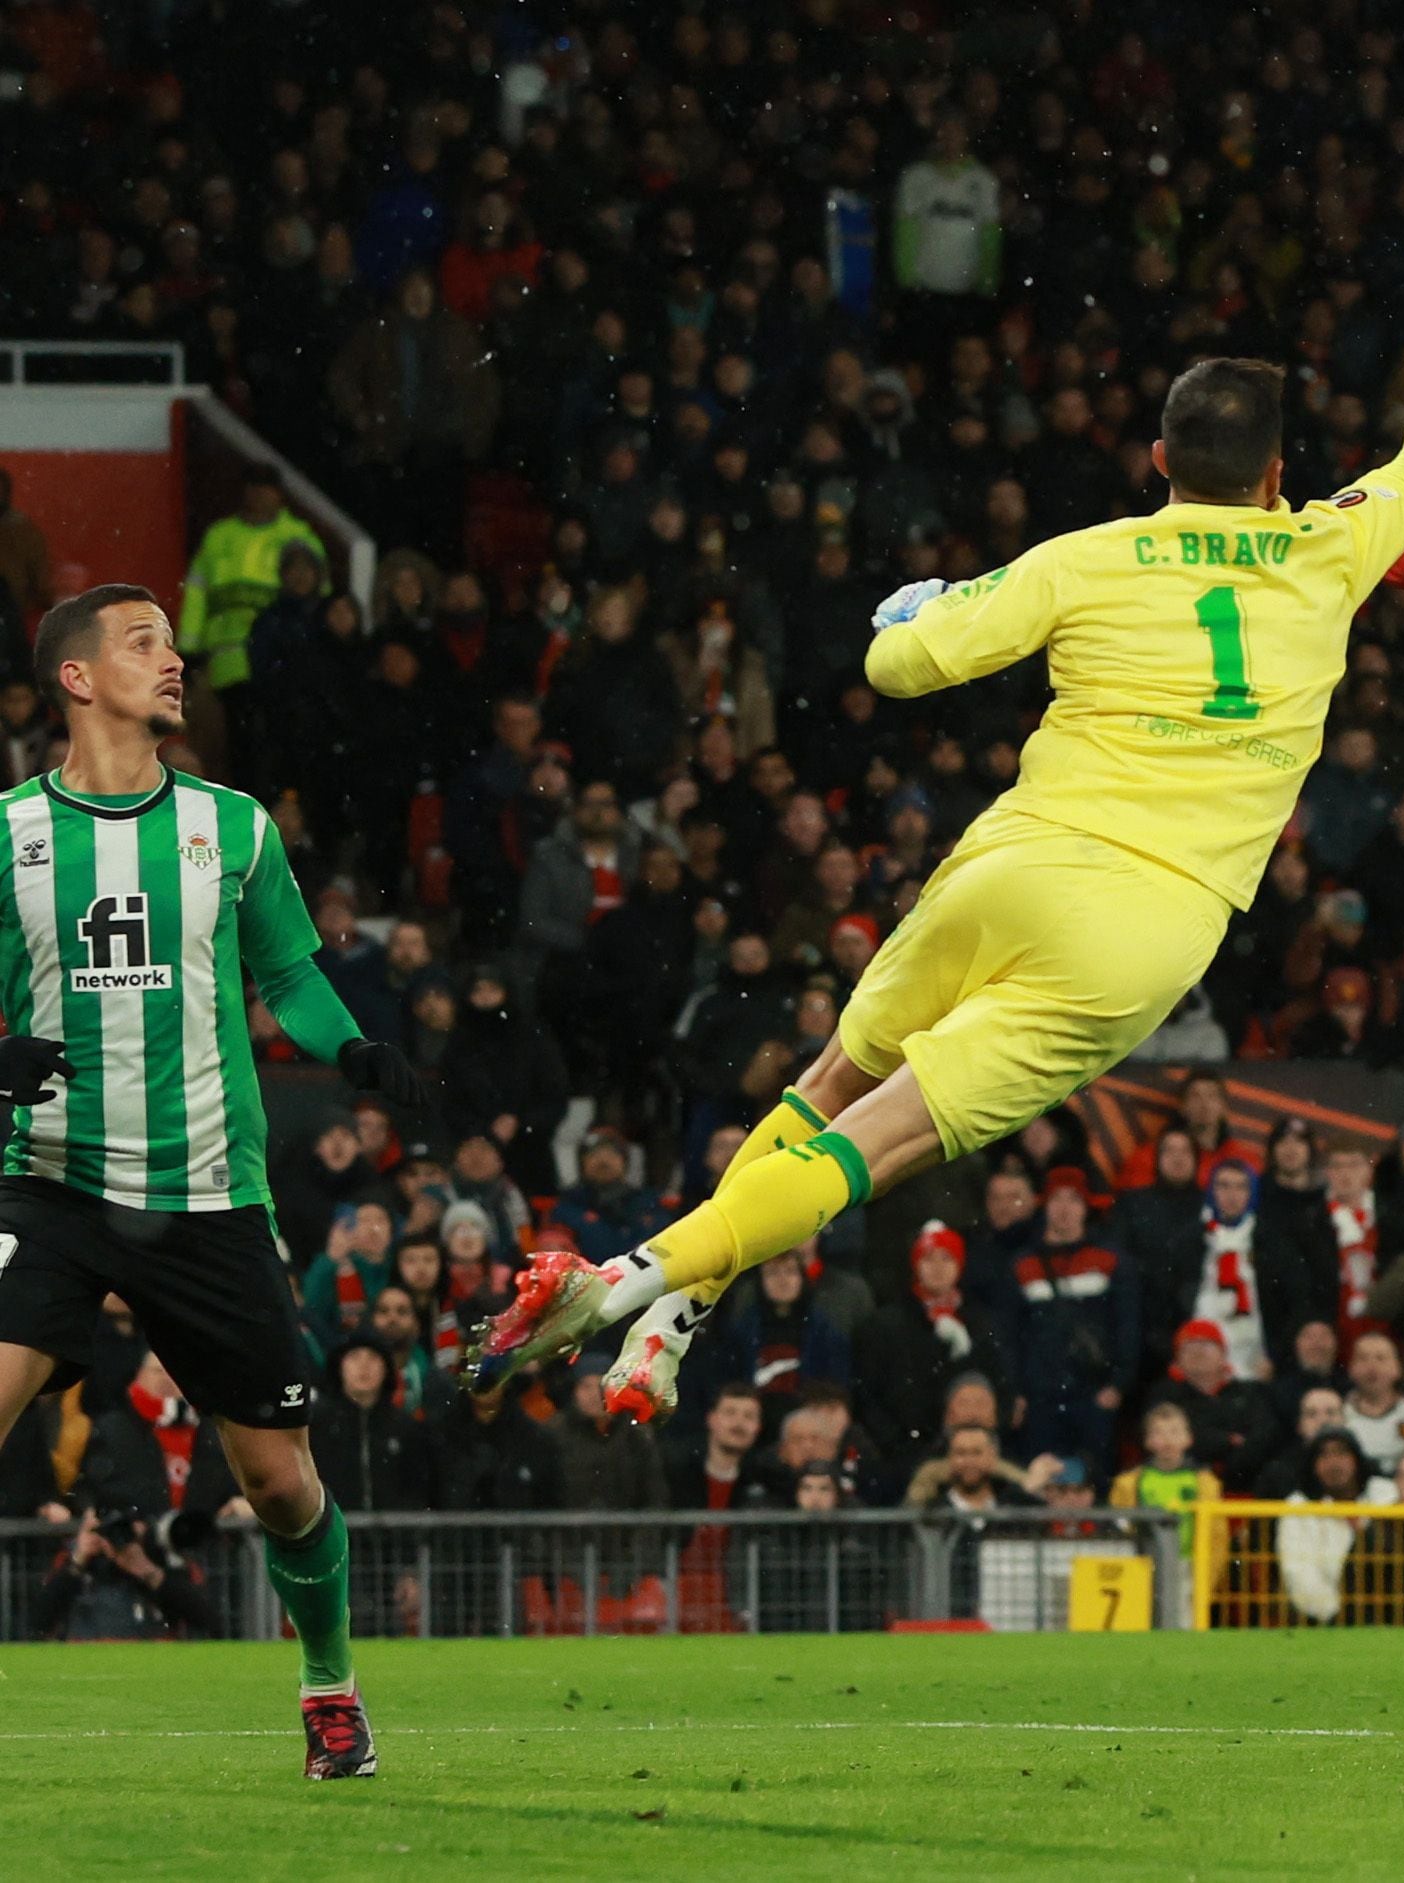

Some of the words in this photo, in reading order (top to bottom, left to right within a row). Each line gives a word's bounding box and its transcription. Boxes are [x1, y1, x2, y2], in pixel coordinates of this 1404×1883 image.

[1135, 536, 1170, 565] C.
[1177, 531, 1293, 566] BRAVO
[1194, 586, 1261, 719] 1
[75, 970, 165, 988] network
[1100, 1588, 1122, 1632] 7
